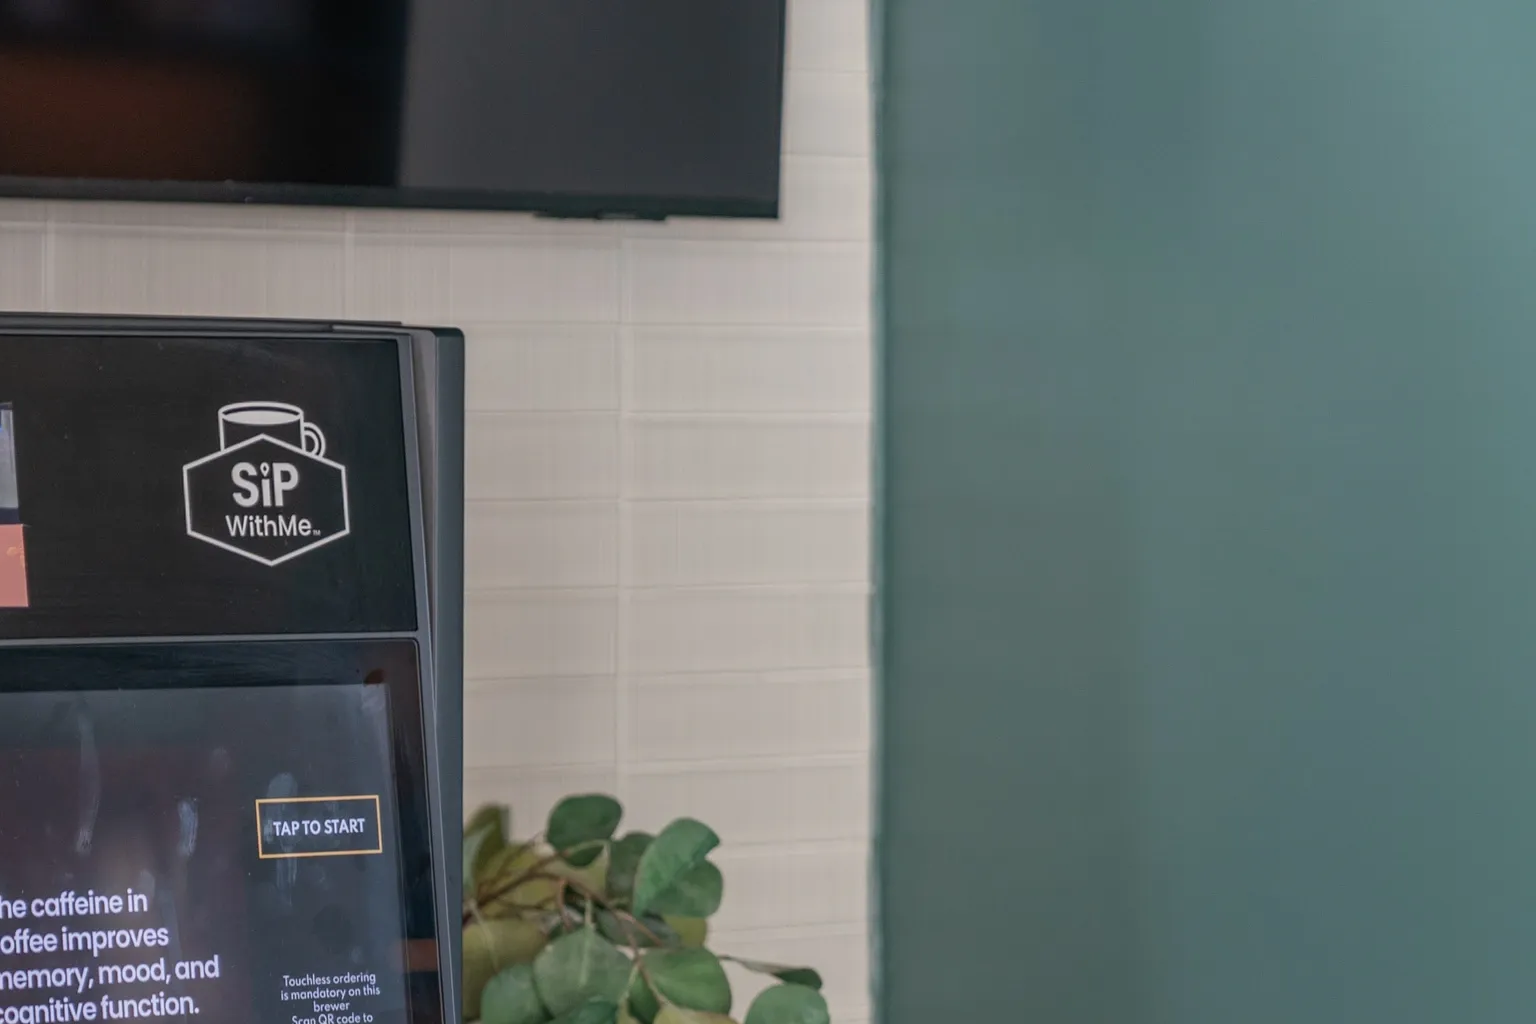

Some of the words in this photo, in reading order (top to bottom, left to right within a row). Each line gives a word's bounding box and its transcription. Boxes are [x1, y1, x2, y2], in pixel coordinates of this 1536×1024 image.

[231, 462, 299, 508] SiP
[273, 820, 299, 836] TAP
[302, 820, 321, 835] TO
[324, 818, 365, 834] START
[31, 889, 123, 917] caffeine
[127, 888, 148, 913] in
[62, 926, 169, 957] improves
[98, 957, 171, 985] mood,
[175, 955, 220, 980] and
[283, 974, 331, 987] Touchless
[333, 972, 376, 984] ordering
[281, 990, 289, 1001] is
[291, 987, 346, 999] mandatory
[348, 987, 361, 996] on
[363, 984, 380, 995] this
[101, 991, 199, 1020] function.
[313, 1001, 350, 1012] brewer
[336, 1012, 361, 1024] code
[363, 1012, 373, 1023] to
